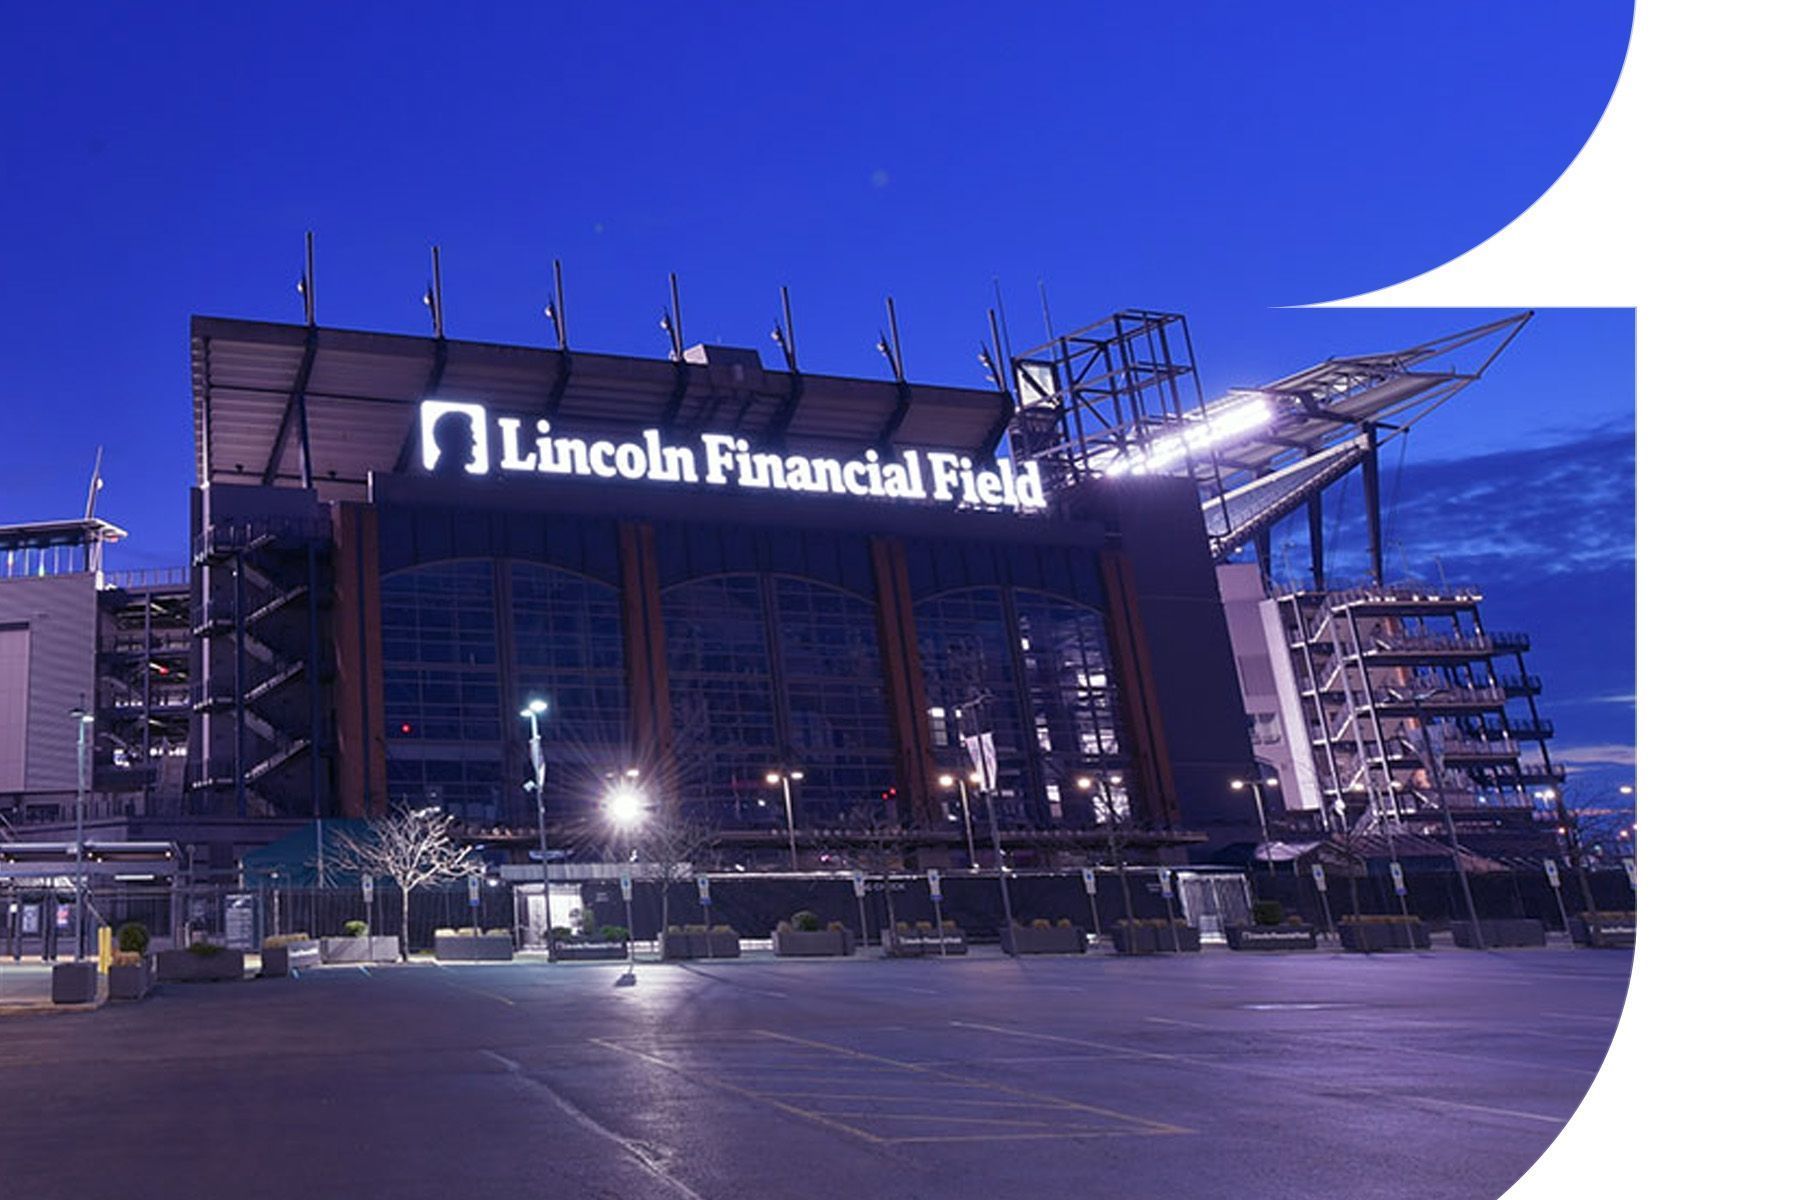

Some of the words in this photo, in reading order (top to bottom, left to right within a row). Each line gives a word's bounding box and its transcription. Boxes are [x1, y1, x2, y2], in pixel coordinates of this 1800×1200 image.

[498, 418, 698, 482] Lincoln
[701, 433, 926, 499] Financial
[928, 452, 1046, 507] Field
